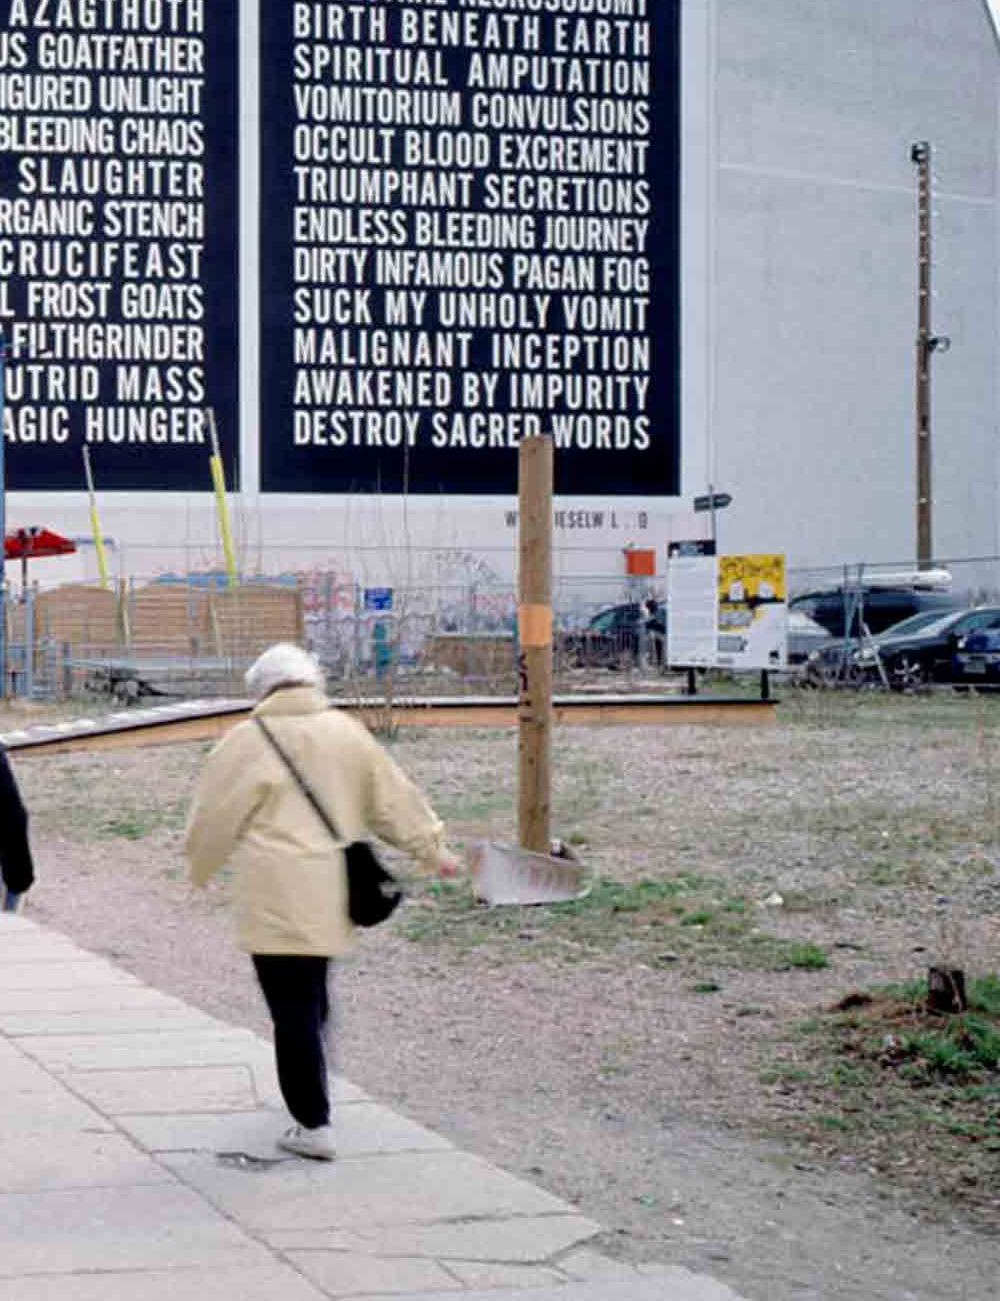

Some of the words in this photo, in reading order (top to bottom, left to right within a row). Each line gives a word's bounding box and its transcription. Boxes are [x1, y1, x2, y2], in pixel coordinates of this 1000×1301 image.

[294, 3, 386, 40] BIRTH
[402, 8, 539, 48] BENEATH
[556, 17, 650, 54] EARTH
[39, 35, 204, 72] GOATFATHER
[294, 43, 449, 83] SPIRITUAL
[468, 52, 649, 93] AMPUTATION
[100, 77, 205, 113] UNLIGHT
[295, 84, 461, 124] VOMITORIUM
[473, 92, 650, 133] CONVULSIONS
[121, 119, 205, 154] CHAOS
[294, 125, 397, 162] OCCULT
[405, 130, 490, 166] BLOOD
[500, 134, 653, 173] EXCREMENT
[19, 159, 204, 196] SLAUGHTER
[292, 166, 478, 205] TRIUMPHANT
[485, 174, 650, 212] SECRETIONS
[104, 202, 204, 237] STENCH
[295, 206, 408, 242] ENDLESS
[416, 211, 535, 247] BLEEDING
[544, 215, 649, 251] JOURNEY
[295, 247, 367, 281] DIRTY
[377, 250, 504, 286] INFAMOUS
[514, 254, 595, 288] PAGAN
[604, 257, 650, 290] FOG
[28, 283, 110, 316] FROST
[122, 284, 204, 318] GOATS
[294, 288, 372, 322] SUCK
[386, 290, 426, 323] MY
[440, 292, 550, 327] UNHOLY
[563, 295, 652, 330] VOMIT
[12, 324, 204, 359] FILTHGRINDER
[295, 329, 474, 365] MALIGNANT
[493, 333, 650, 369] INCEPTION
[118, 367, 205, 401] MASS
[294, 369, 451, 404] AWAKENED
[464, 373, 498, 405] BY
[511, 374, 649, 408] IMPURITY
[86, 407, 206, 441] HUNGER
[295, 410, 421, 444] DESTROY
[432, 412, 541, 446] SACRED
[552, 414, 651, 448] WORDS
